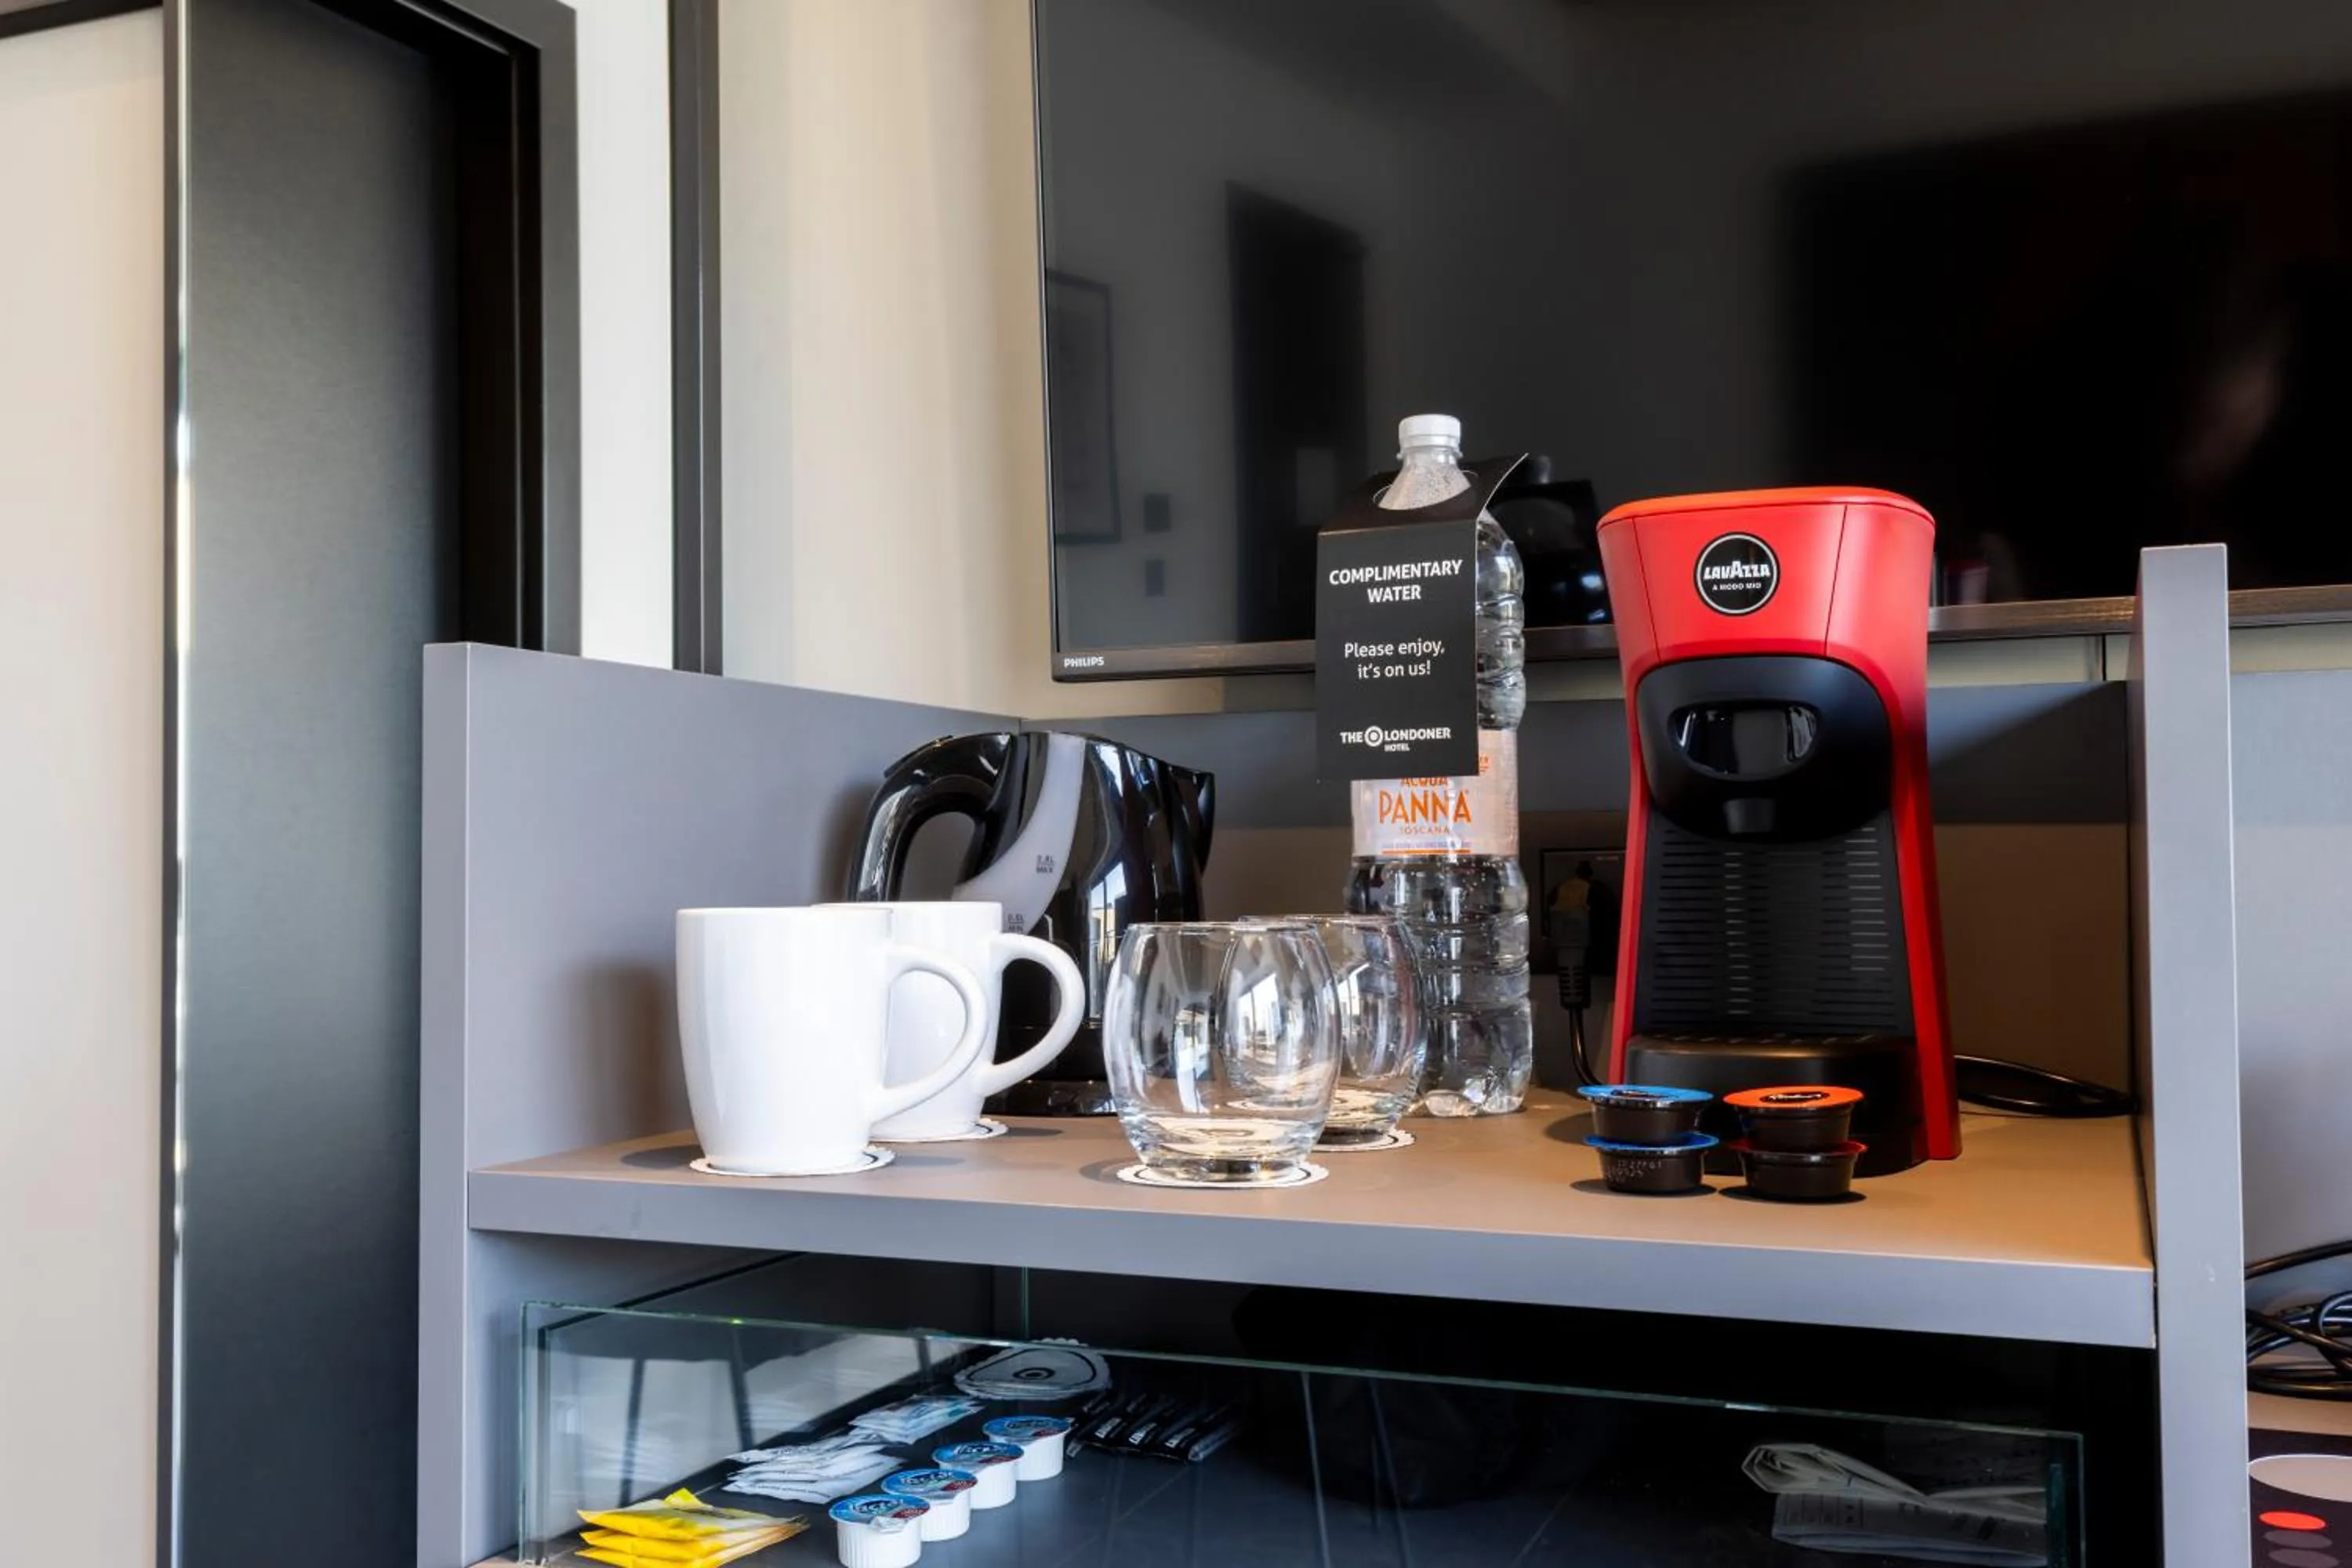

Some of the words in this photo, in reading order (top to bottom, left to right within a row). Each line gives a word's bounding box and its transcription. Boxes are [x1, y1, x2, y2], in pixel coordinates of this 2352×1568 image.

[1329, 559, 1463, 586] COMPLIMENTARY
[1703, 561, 1770, 580] LAVAZZA
[1367, 585, 1421, 603] WATER
[1344, 641, 1394, 659] Please
[1398, 637, 1445, 657] enjoy,
[1064, 656, 1105, 668] PHILIPS
[1385, 665, 1404, 677] on
[1408, 659, 1431, 676] us!
[1340, 731, 1363, 745] THE
[1384, 727, 1451, 742] LONDONER
[1385, 743, 1410, 753] HOTEL
[1378, 789, 1472, 824] PANNA
